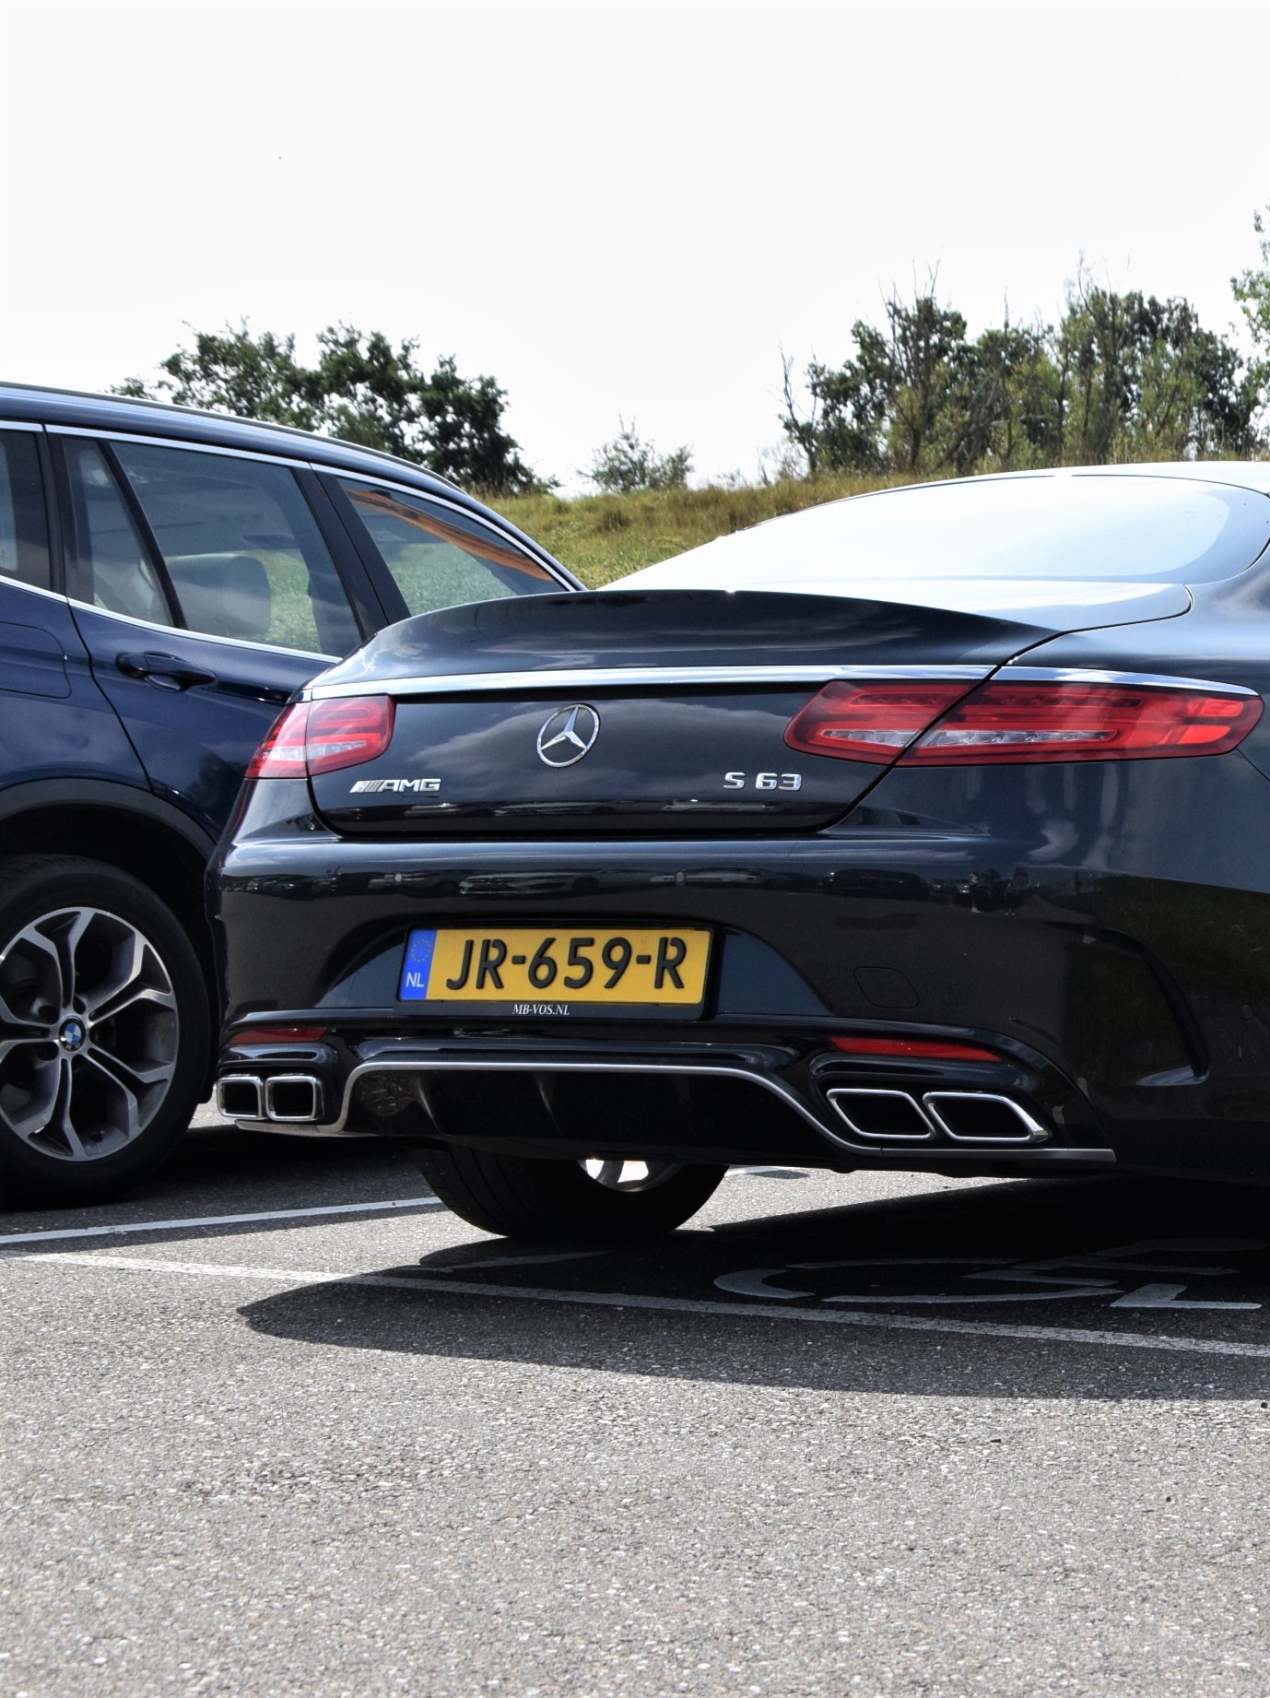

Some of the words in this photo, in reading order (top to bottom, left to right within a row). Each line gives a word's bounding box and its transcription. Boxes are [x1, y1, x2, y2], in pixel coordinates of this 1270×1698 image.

[377, 779, 441, 792] AMG
[723, 772, 745, 789] S
[755, 773, 802, 791] 63
[446, 937, 687, 990] JR-659-R
[405, 972, 424, 988] NL
[512, 1003, 570, 1016] MB-VOS.NL
